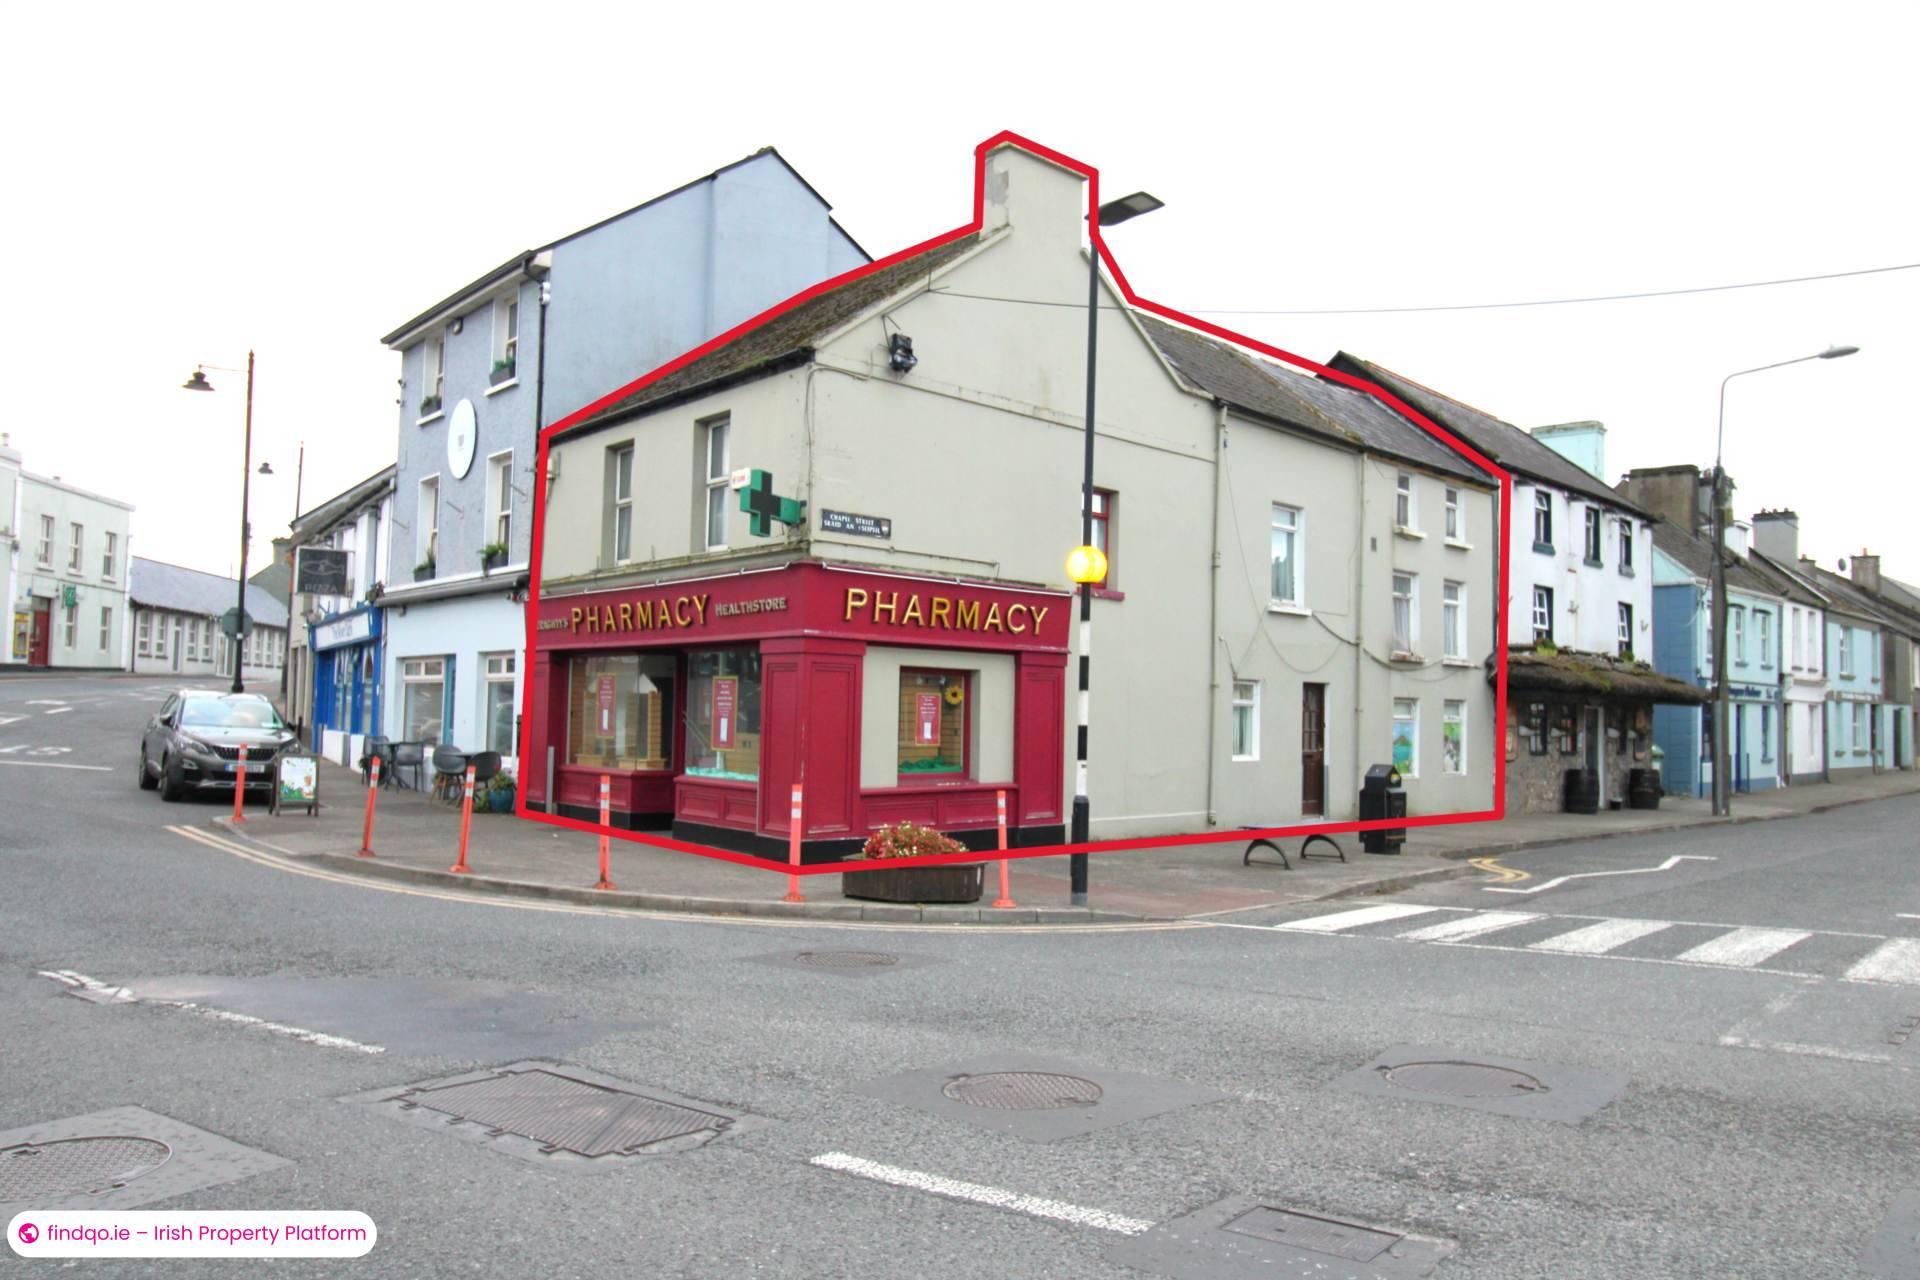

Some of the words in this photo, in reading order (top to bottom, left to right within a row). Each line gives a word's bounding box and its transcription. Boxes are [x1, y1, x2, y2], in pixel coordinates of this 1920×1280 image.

[830, 514, 850, 523] CHAPEL
[855, 517, 874, 526] STREET
[304, 583, 338, 595] PIZZA
[571, 594, 708, 634] PHARMACY
[715, 597, 787, 617] HEALTHSTORE
[844, 588, 1049, 635] PHARMACY
